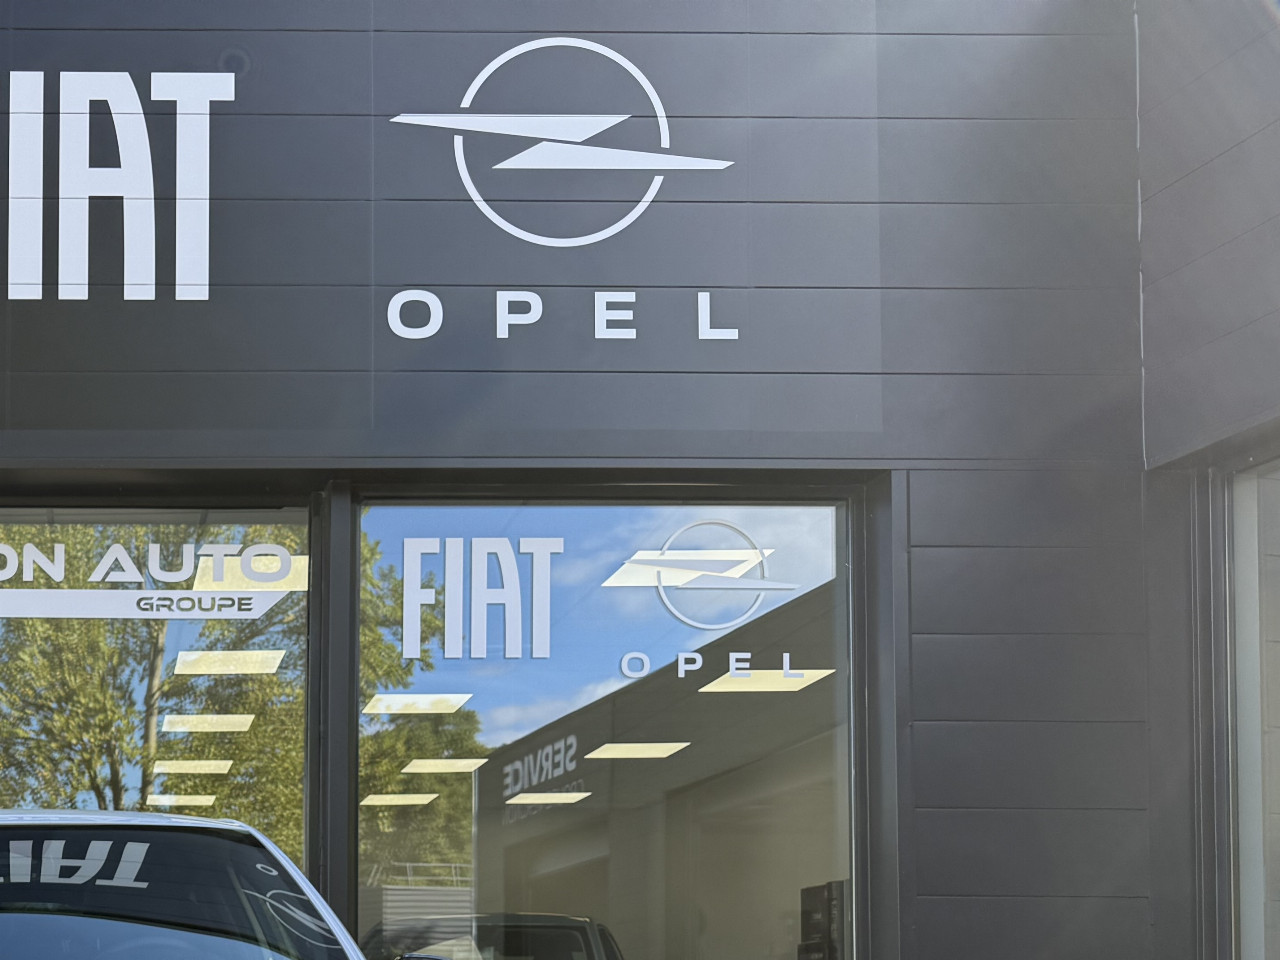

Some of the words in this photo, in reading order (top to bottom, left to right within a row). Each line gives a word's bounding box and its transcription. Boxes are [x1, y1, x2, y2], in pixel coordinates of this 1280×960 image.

[386, 289, 740, 341] OPEL
[88, 543, 292, 582] AUTO
[136, 596, 254, 613] GROUPE
[402, 537, 565, 659] FIAT
[620, 651, 806, 679] OPEL
